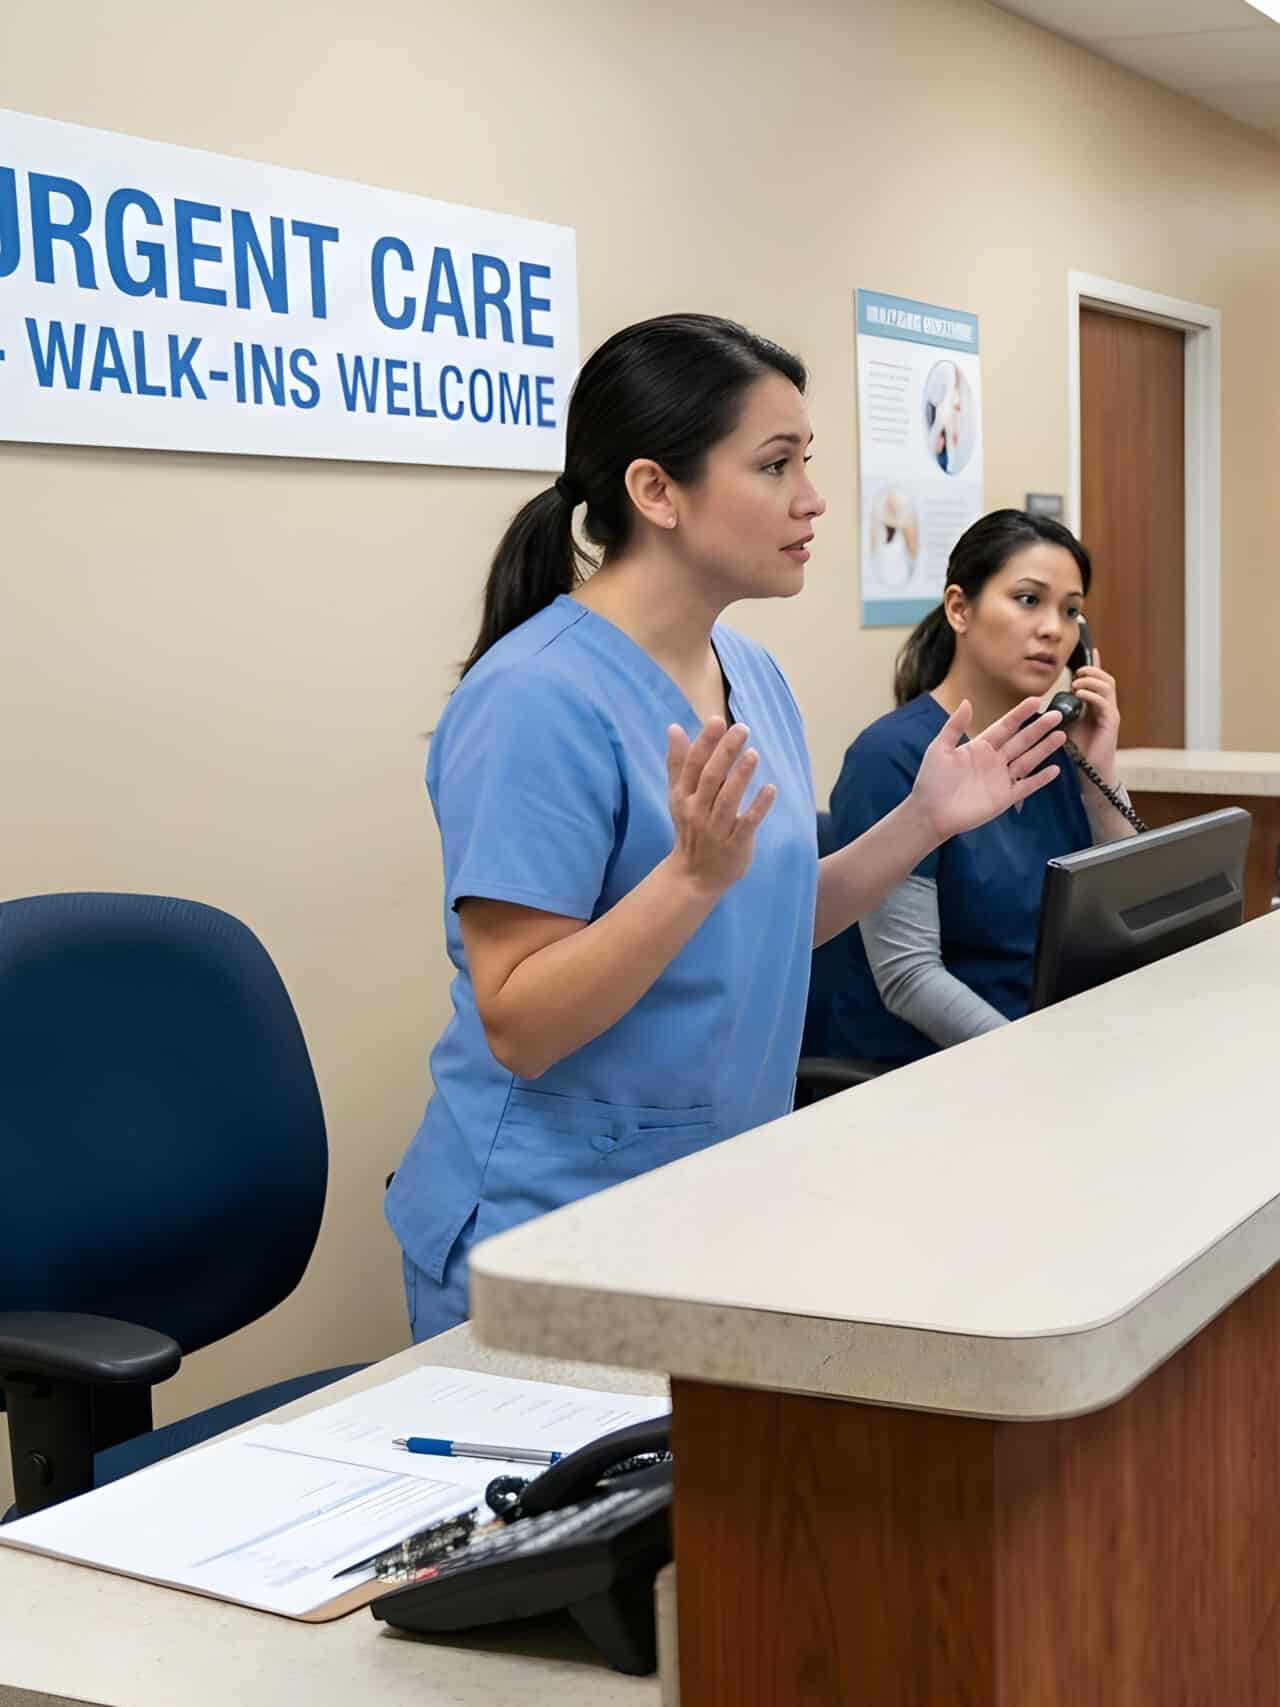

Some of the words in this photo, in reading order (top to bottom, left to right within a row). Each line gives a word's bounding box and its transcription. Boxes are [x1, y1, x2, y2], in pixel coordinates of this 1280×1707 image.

[370, 236, 554, 349] CARE
[25, 316, 321, 410] WALK-INS
[336, 352, 557, 429] WELCOME
